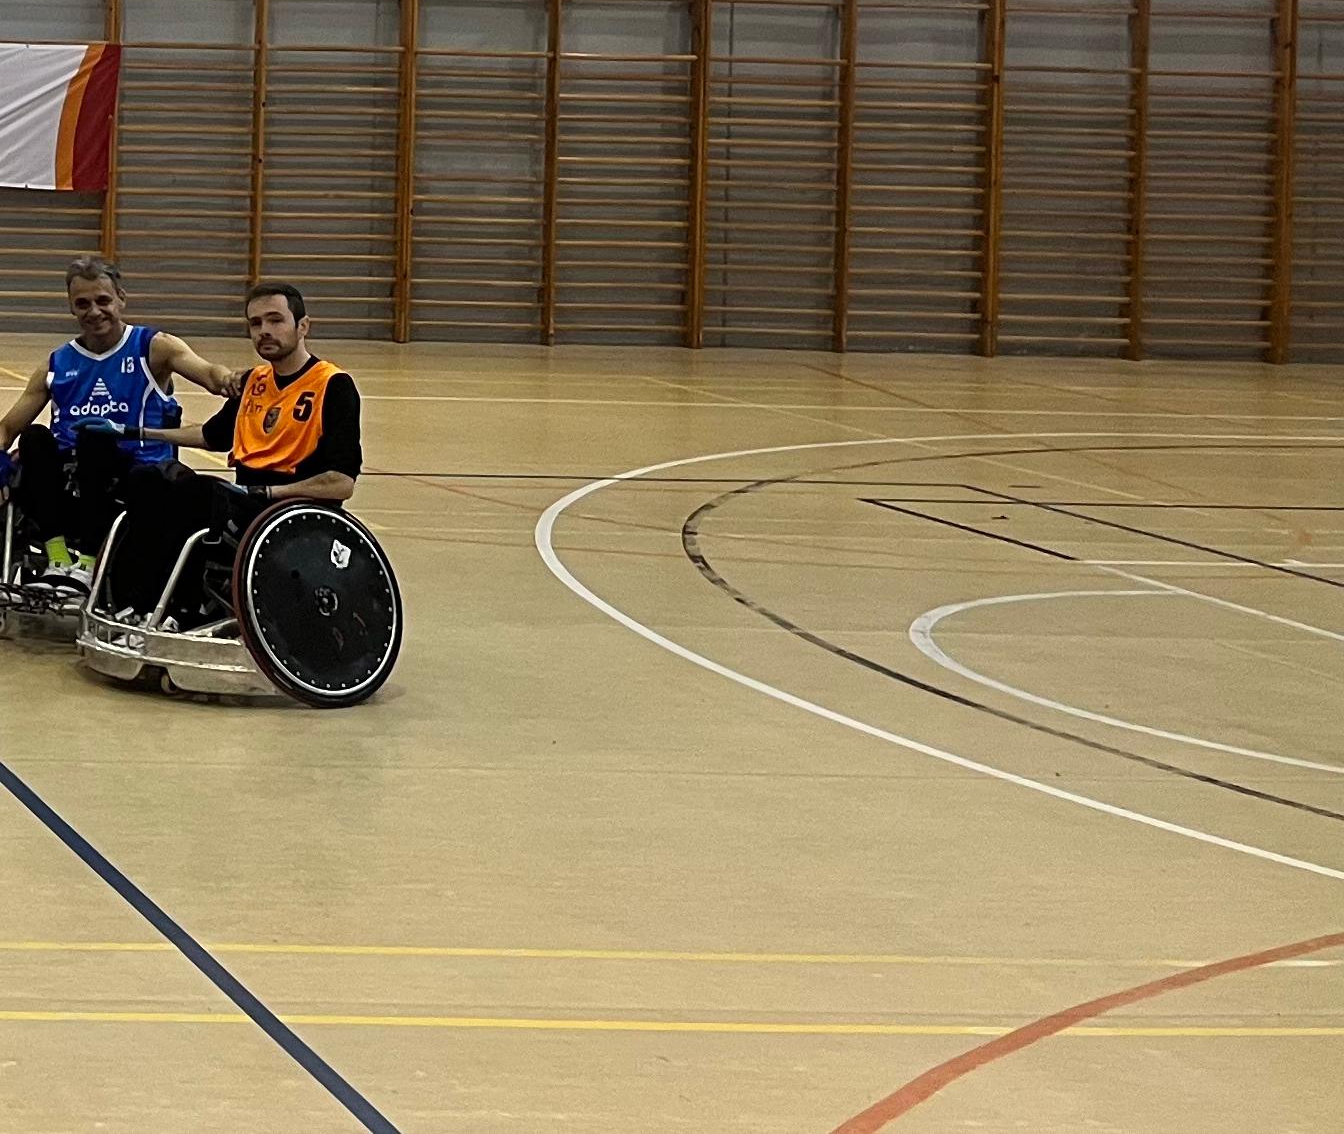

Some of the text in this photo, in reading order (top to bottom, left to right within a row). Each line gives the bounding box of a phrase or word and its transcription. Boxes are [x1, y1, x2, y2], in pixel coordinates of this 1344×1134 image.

[120, 356, 135, 374] 13
[69, 399, 129, 418] adapta
[292, 391, 316, 423] 5
